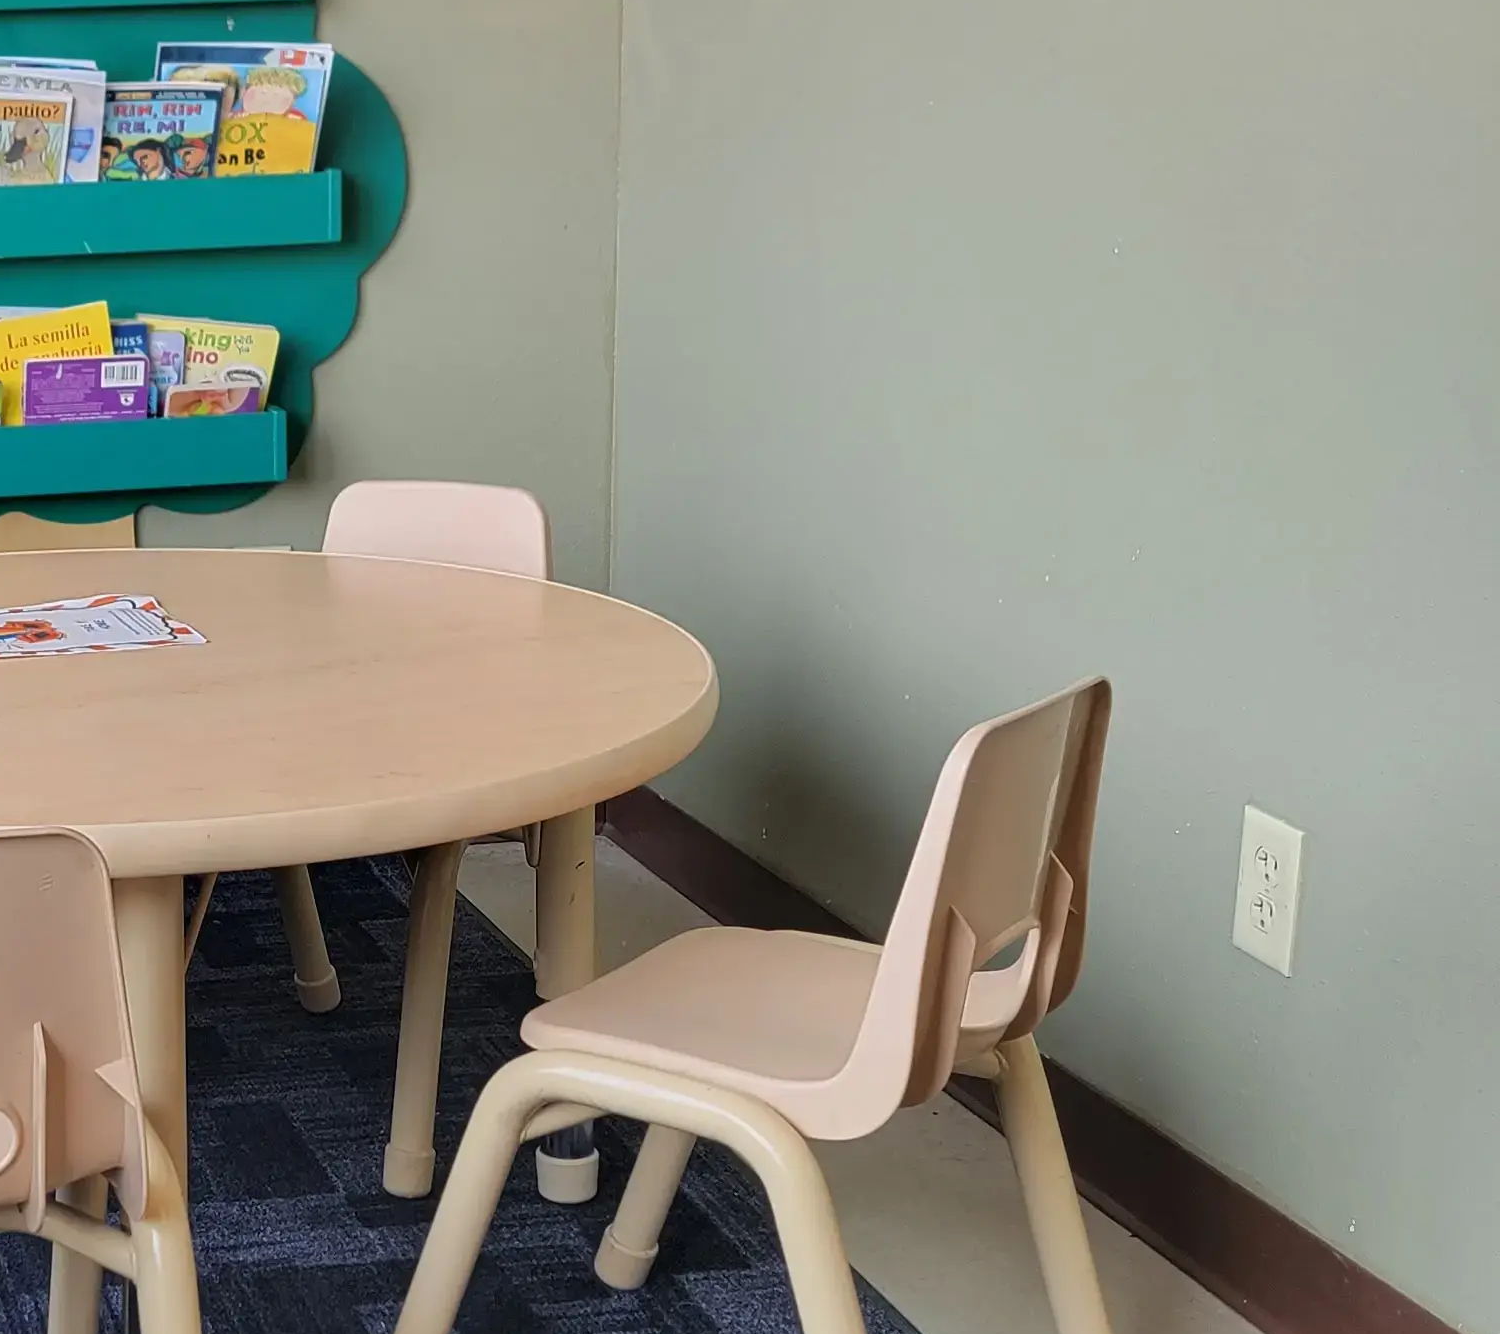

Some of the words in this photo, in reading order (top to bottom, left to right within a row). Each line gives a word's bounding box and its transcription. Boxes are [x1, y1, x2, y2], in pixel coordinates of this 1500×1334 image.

[15, 74, 74, 93] KYLA
[3, 103, 60, 120] patito?
[245, 148, 266, 165] Be
[7, 334, 29, 350] La
[33, 321, 90, 345] semilla
[0, 358, 19, 373] de
